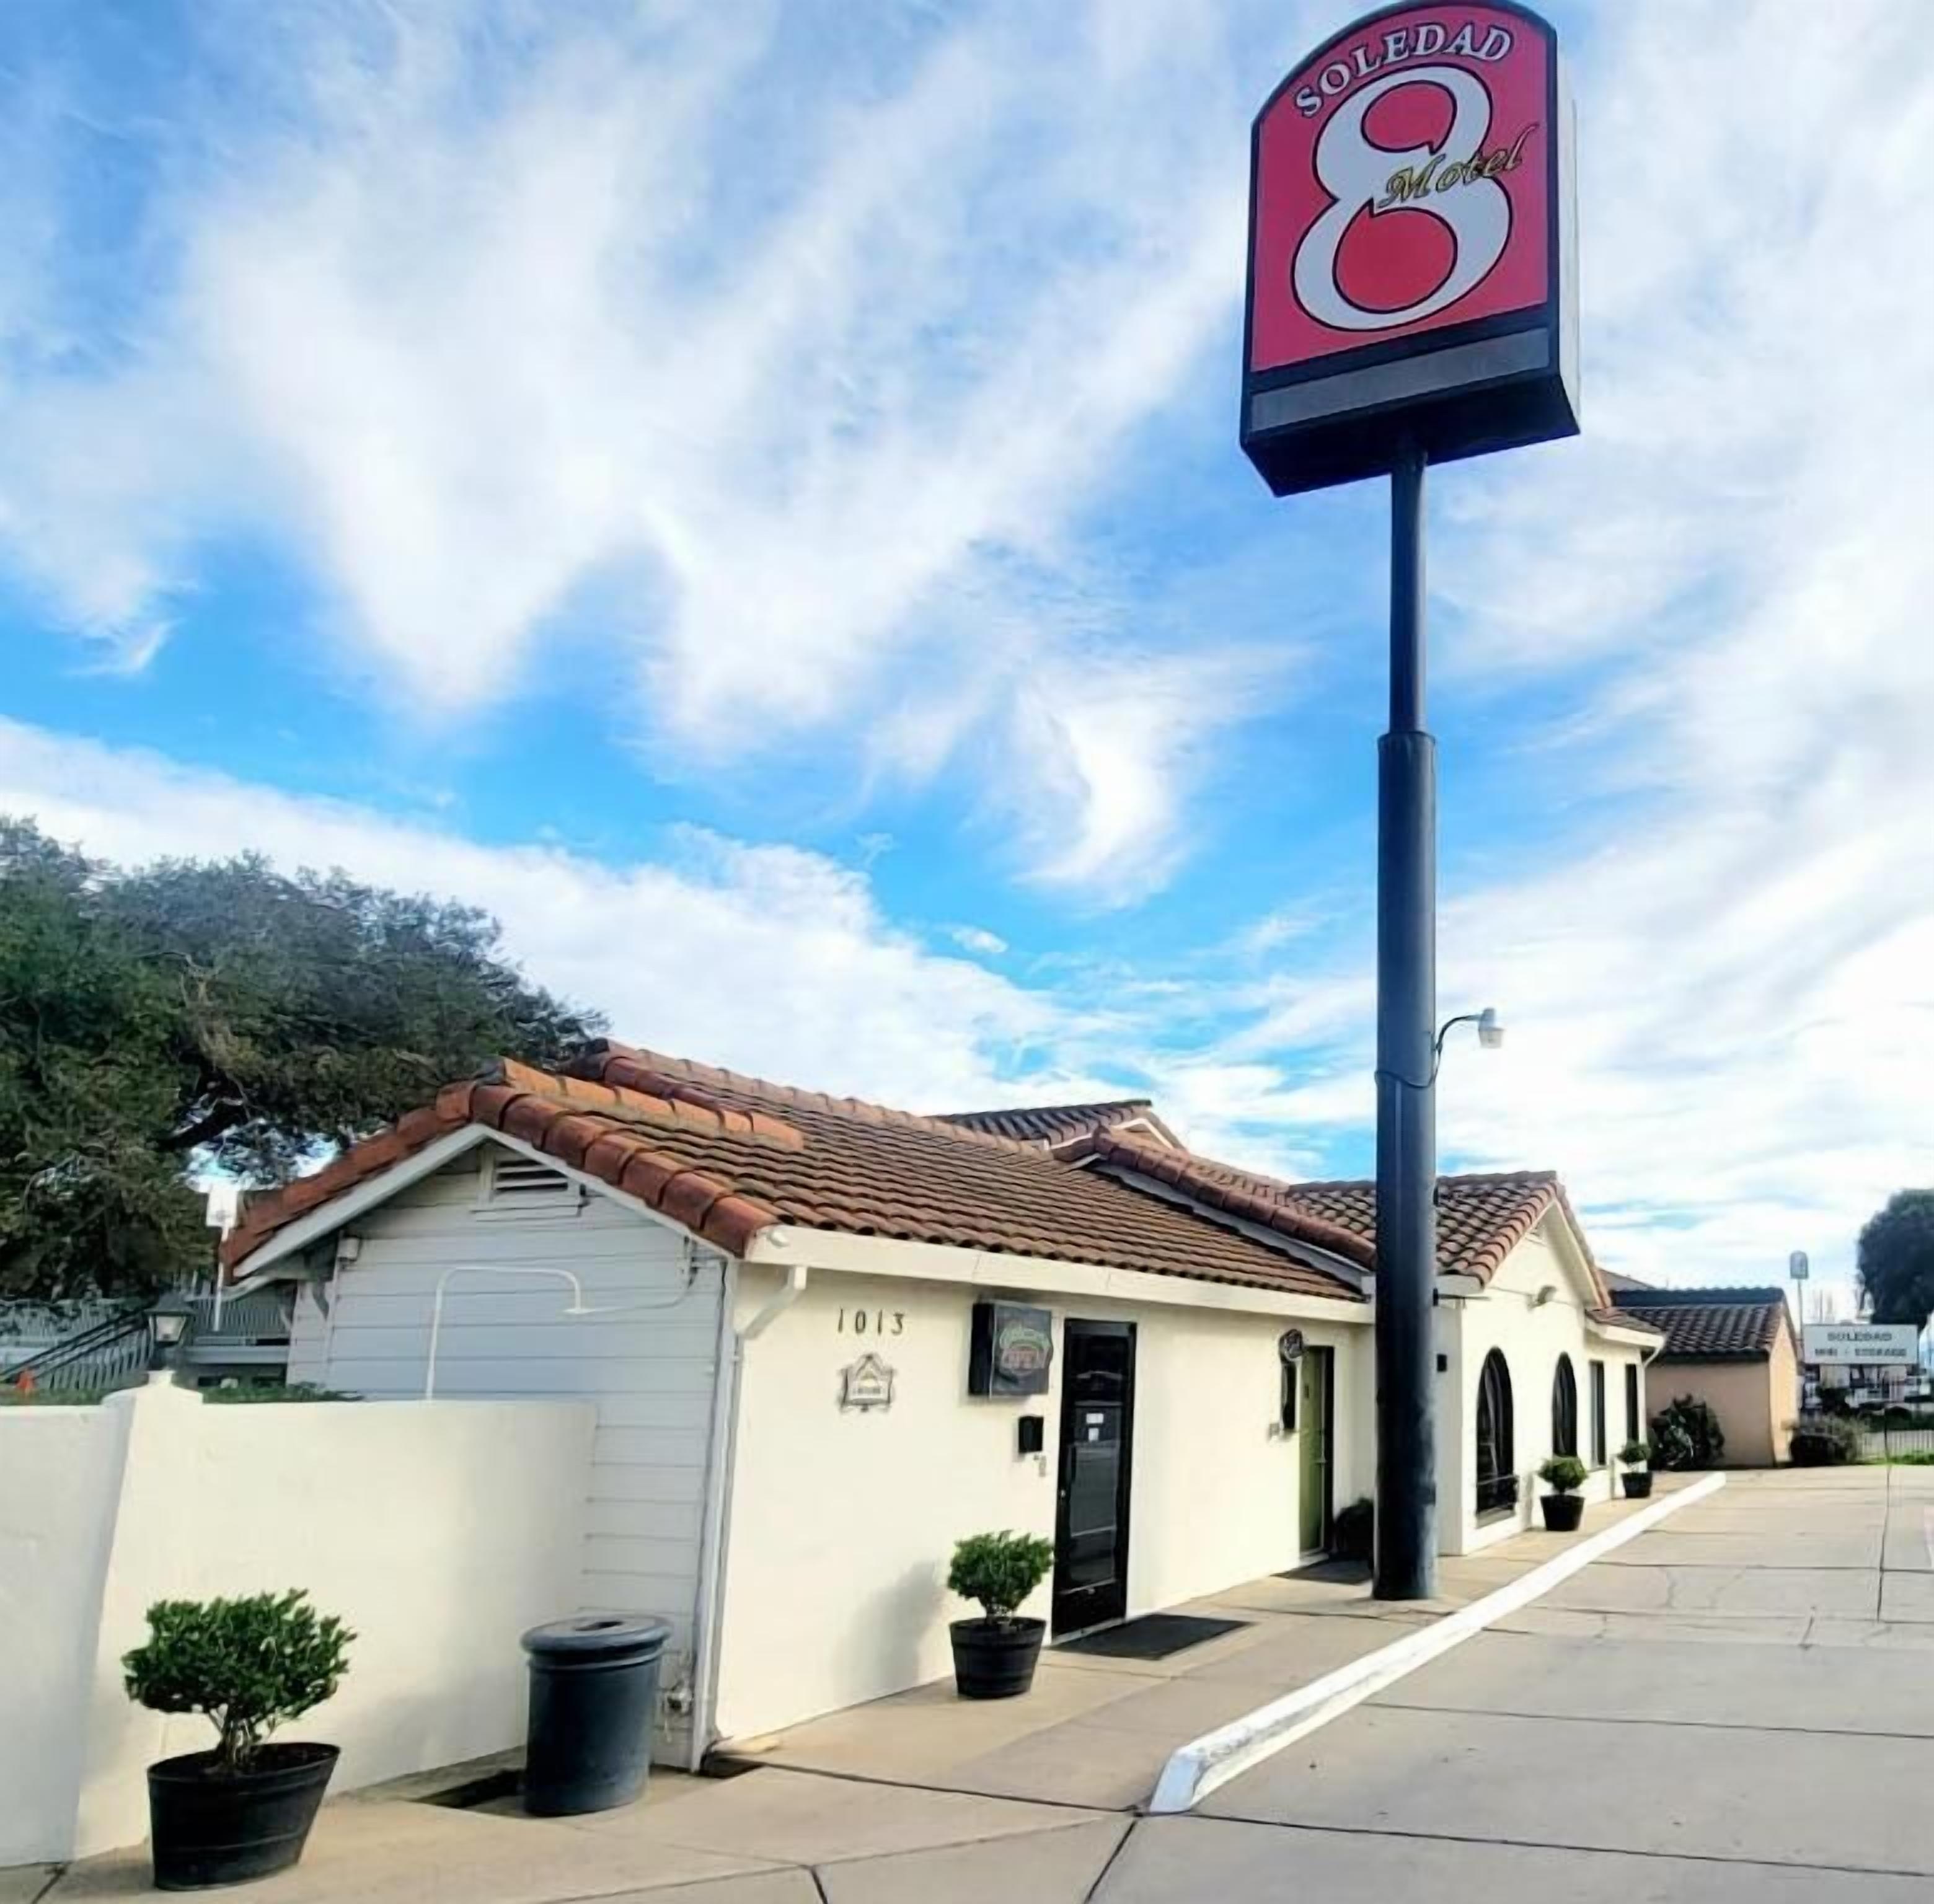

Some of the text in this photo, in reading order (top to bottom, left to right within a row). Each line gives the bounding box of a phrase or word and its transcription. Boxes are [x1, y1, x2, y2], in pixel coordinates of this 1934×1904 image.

[1294, 22, 1513, 118] SOLEDAD
[1291, 63, 1512, 332] 8
[1377, 122, 1540, 208] Motel
[837, 1308, 905, 1336] 1013
